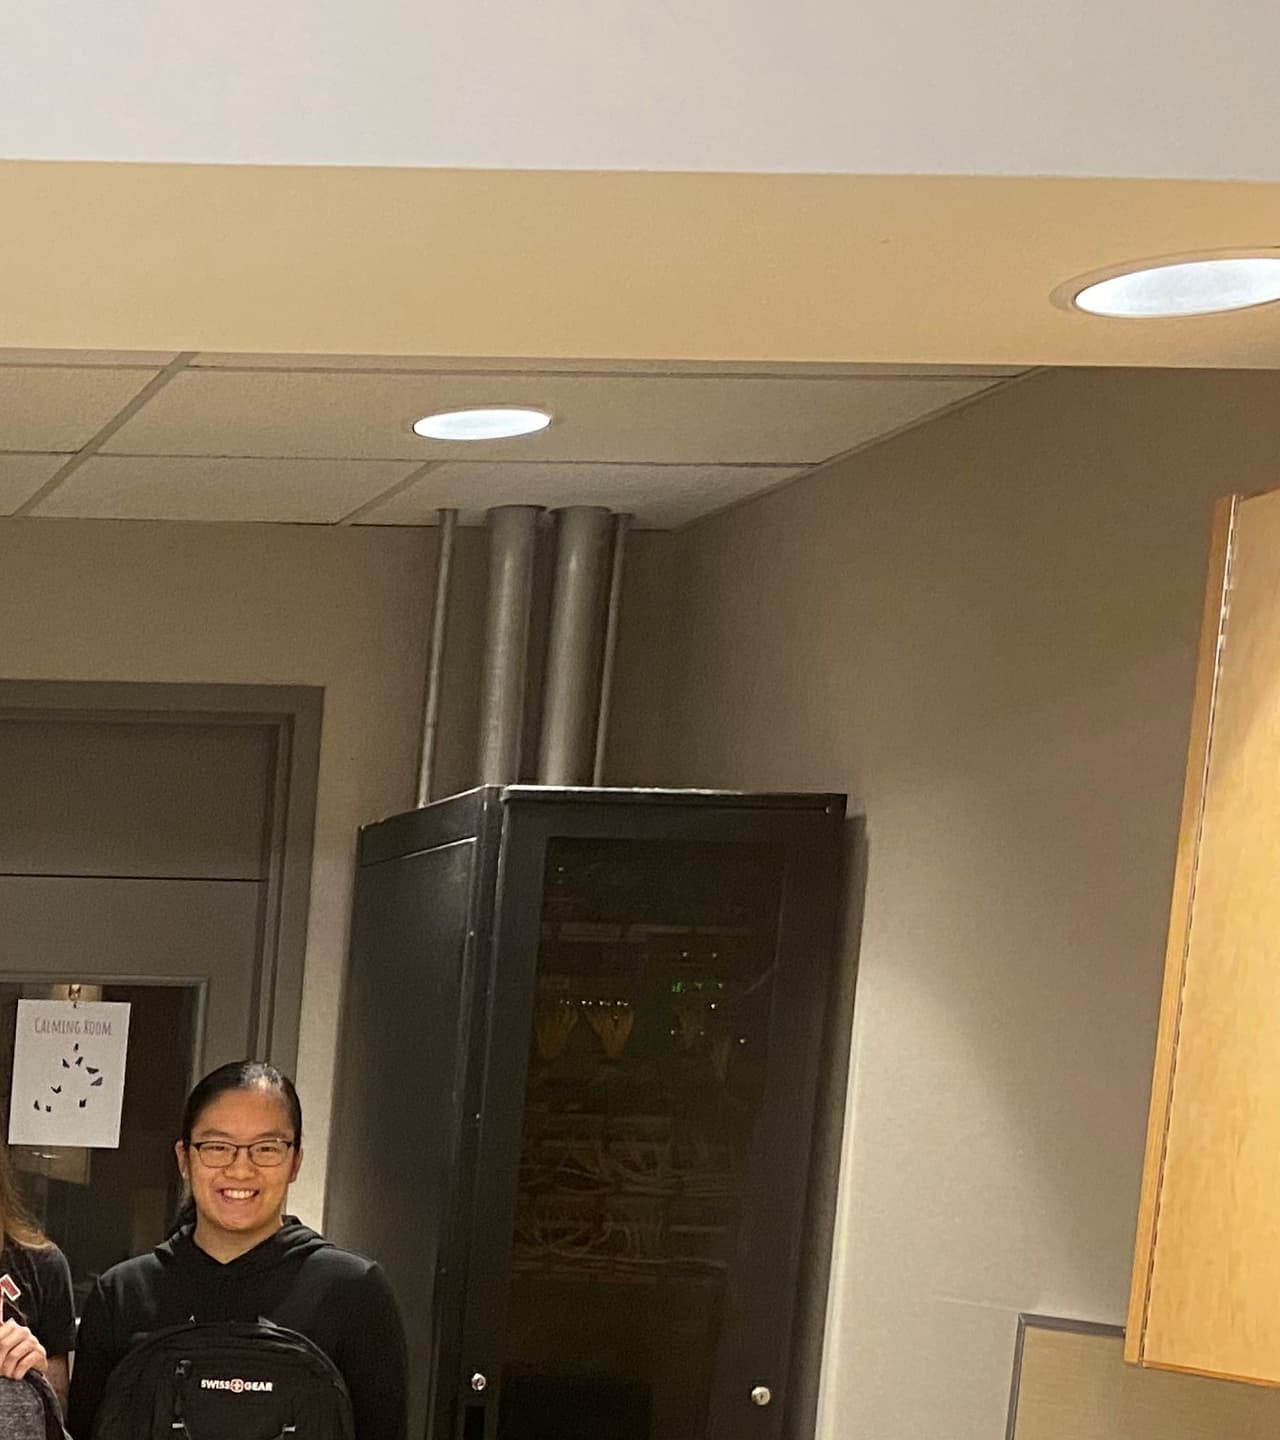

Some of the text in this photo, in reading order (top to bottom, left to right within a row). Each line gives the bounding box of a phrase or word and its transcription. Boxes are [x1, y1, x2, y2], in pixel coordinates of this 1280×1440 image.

[34, 1018, 112, 1036] CALMING ROOM
[201, 1379, 273, 1392] SWISS GEAR
